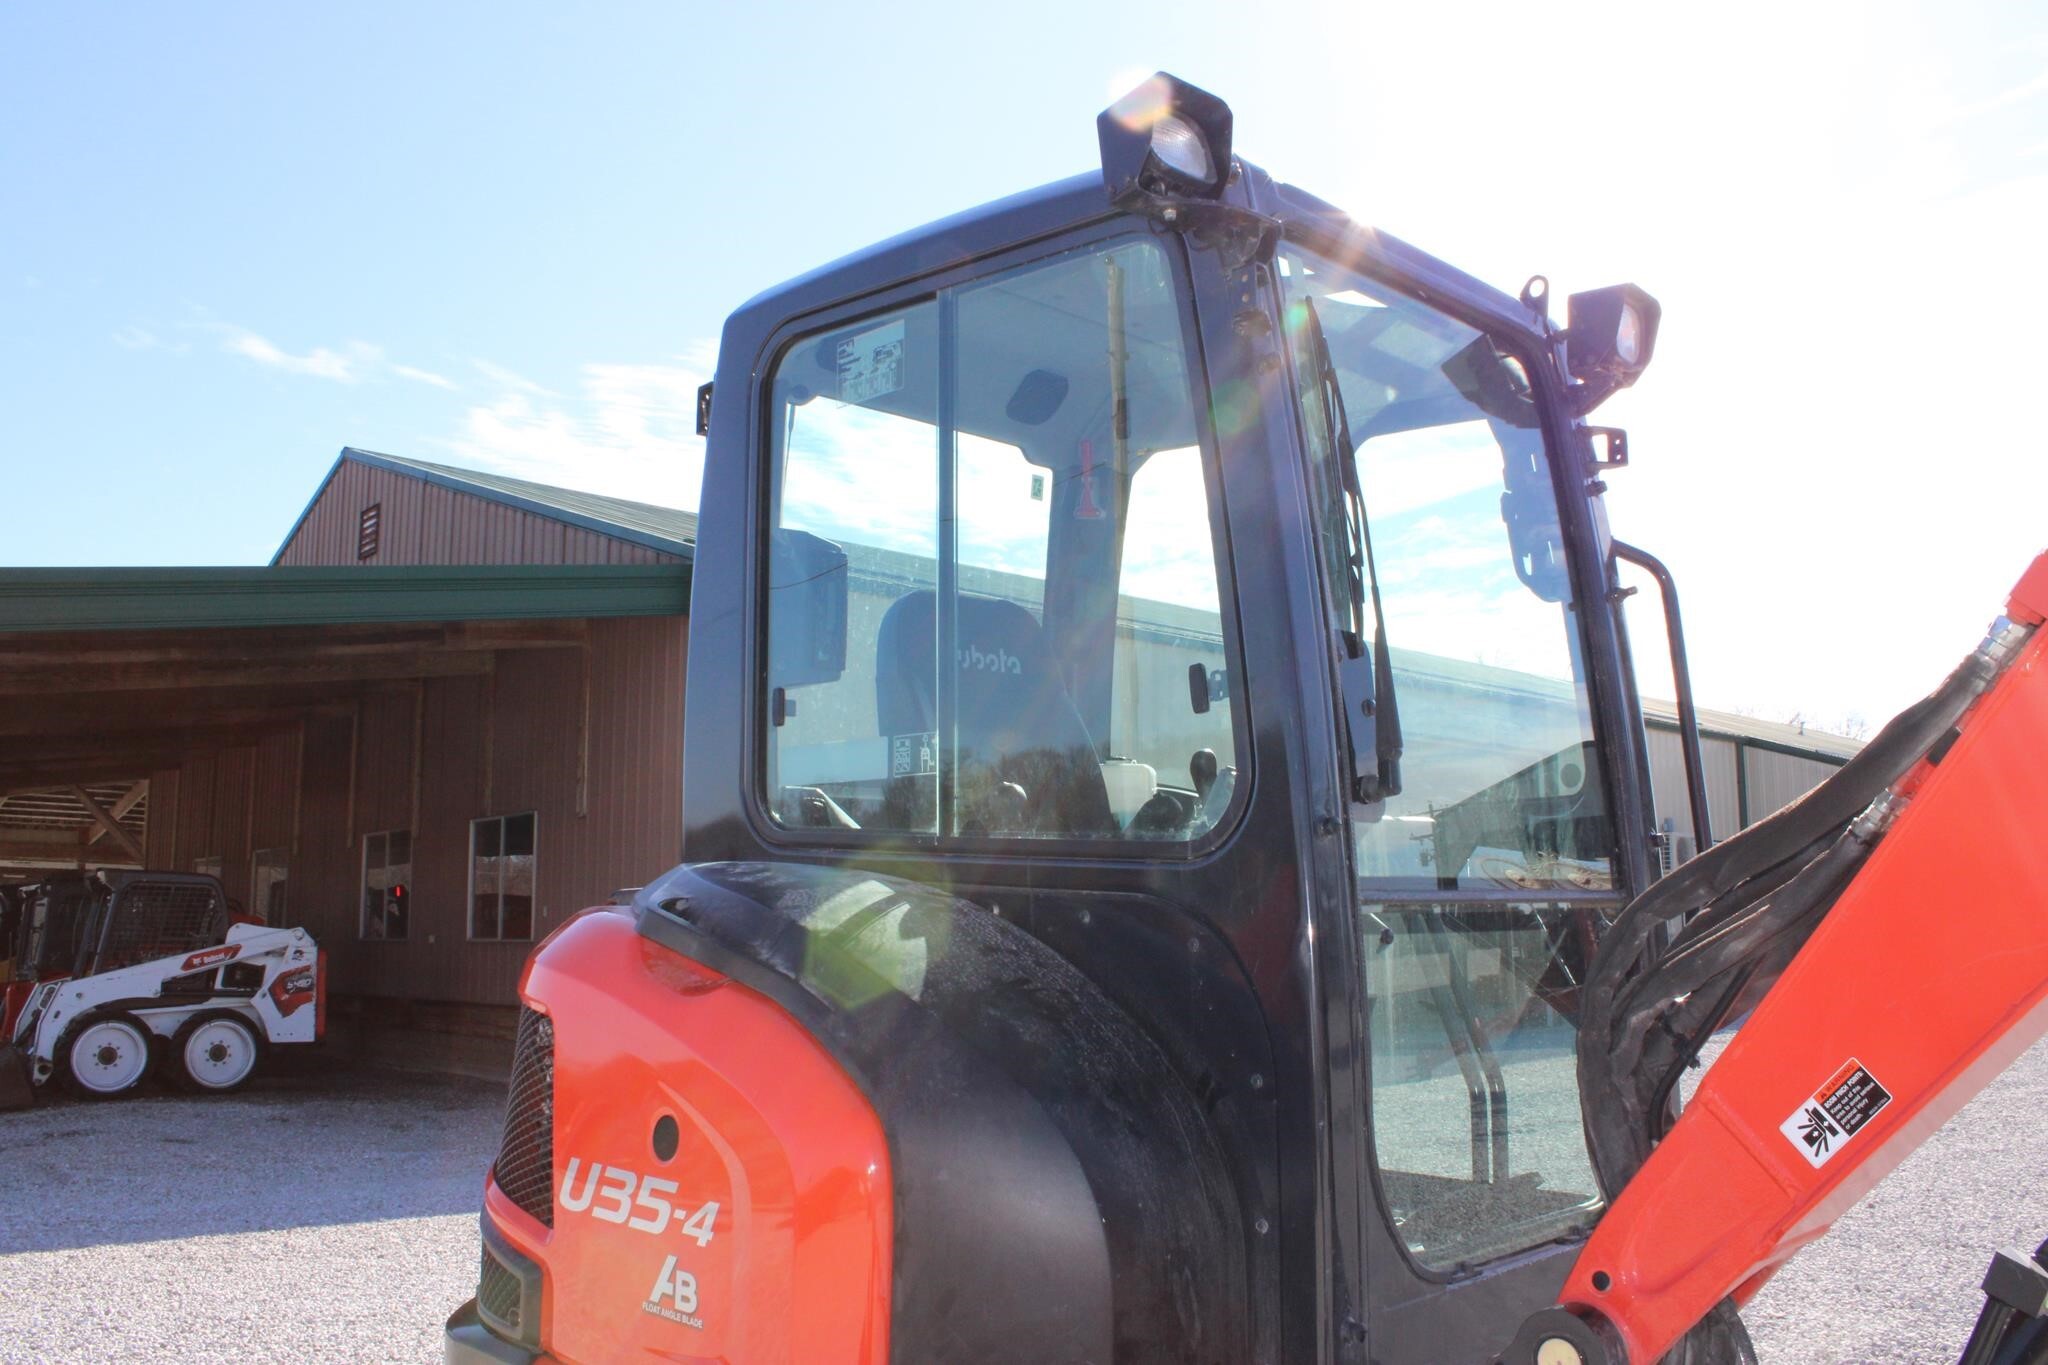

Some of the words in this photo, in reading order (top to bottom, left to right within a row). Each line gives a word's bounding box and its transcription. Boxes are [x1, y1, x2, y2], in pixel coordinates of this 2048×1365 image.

[957, 644, 1022, 674] ubota
[1823, 1094, 1838, 1108] BOOM
[1834, 1084, 1849, 1098] PINCH
[559, 1156, 721, 1248] U35-4
[649, 1254, 698, 1314] AB
[642, 1301, 661, 1317] FLOAT
[661, 1306, 682, 1323] ANGLE
[682, 1312, 704, 1329] BLADE
